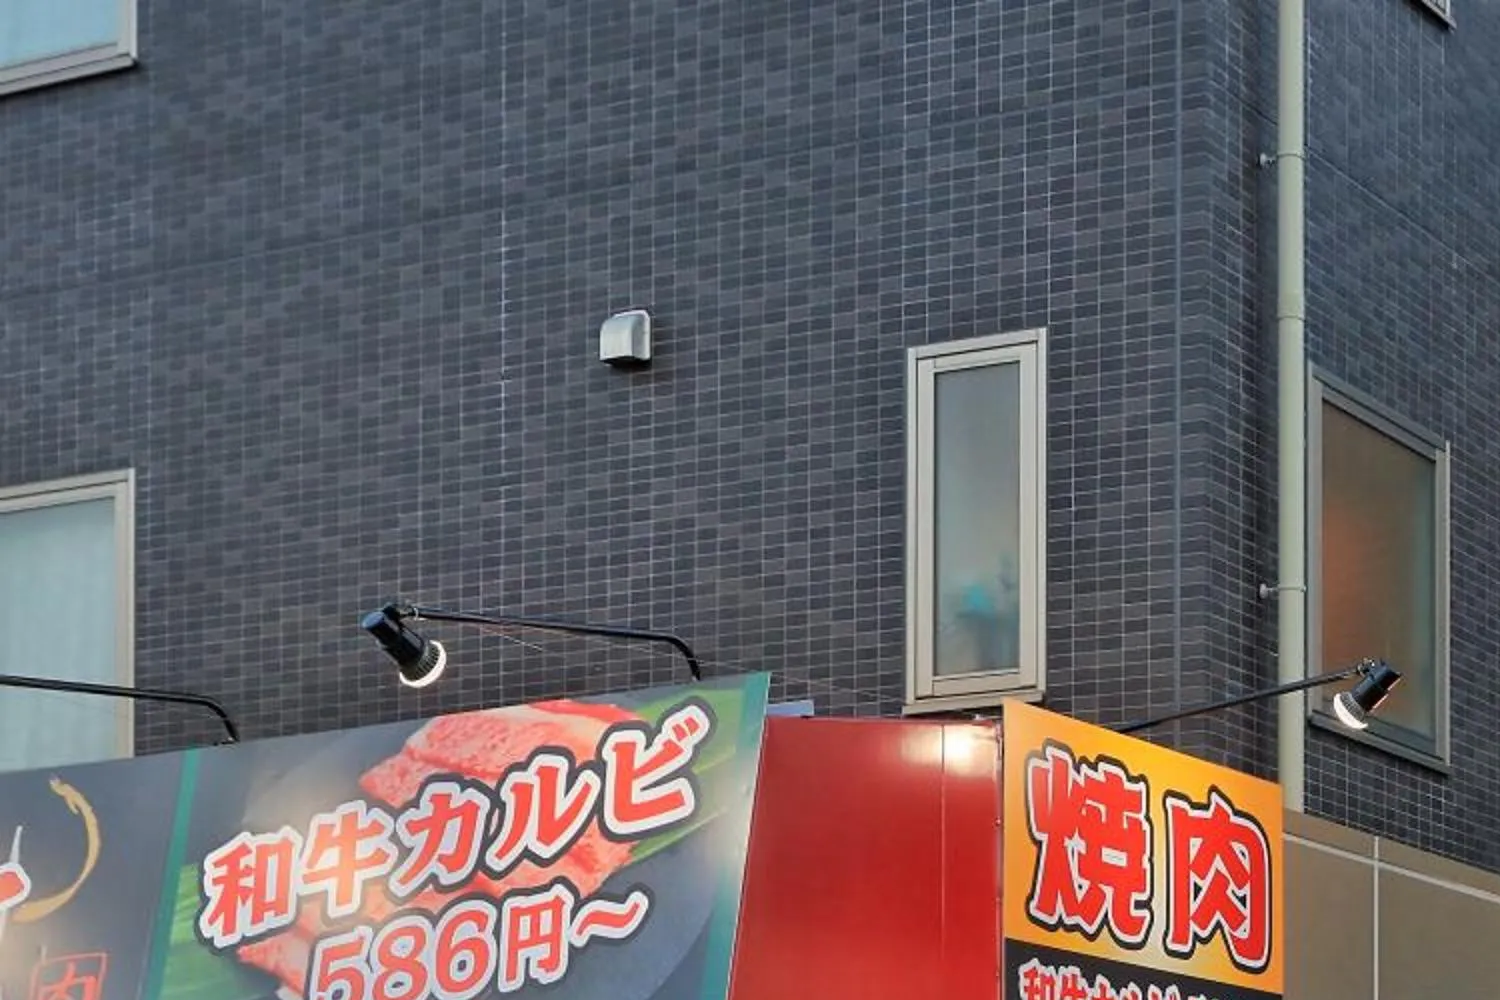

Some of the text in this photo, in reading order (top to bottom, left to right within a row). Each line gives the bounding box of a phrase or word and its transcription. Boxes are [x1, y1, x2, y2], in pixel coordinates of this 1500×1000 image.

[203, 704, 711, 948] 和牛カルビ
[1028, 748, 1271, 967] 焼肉
